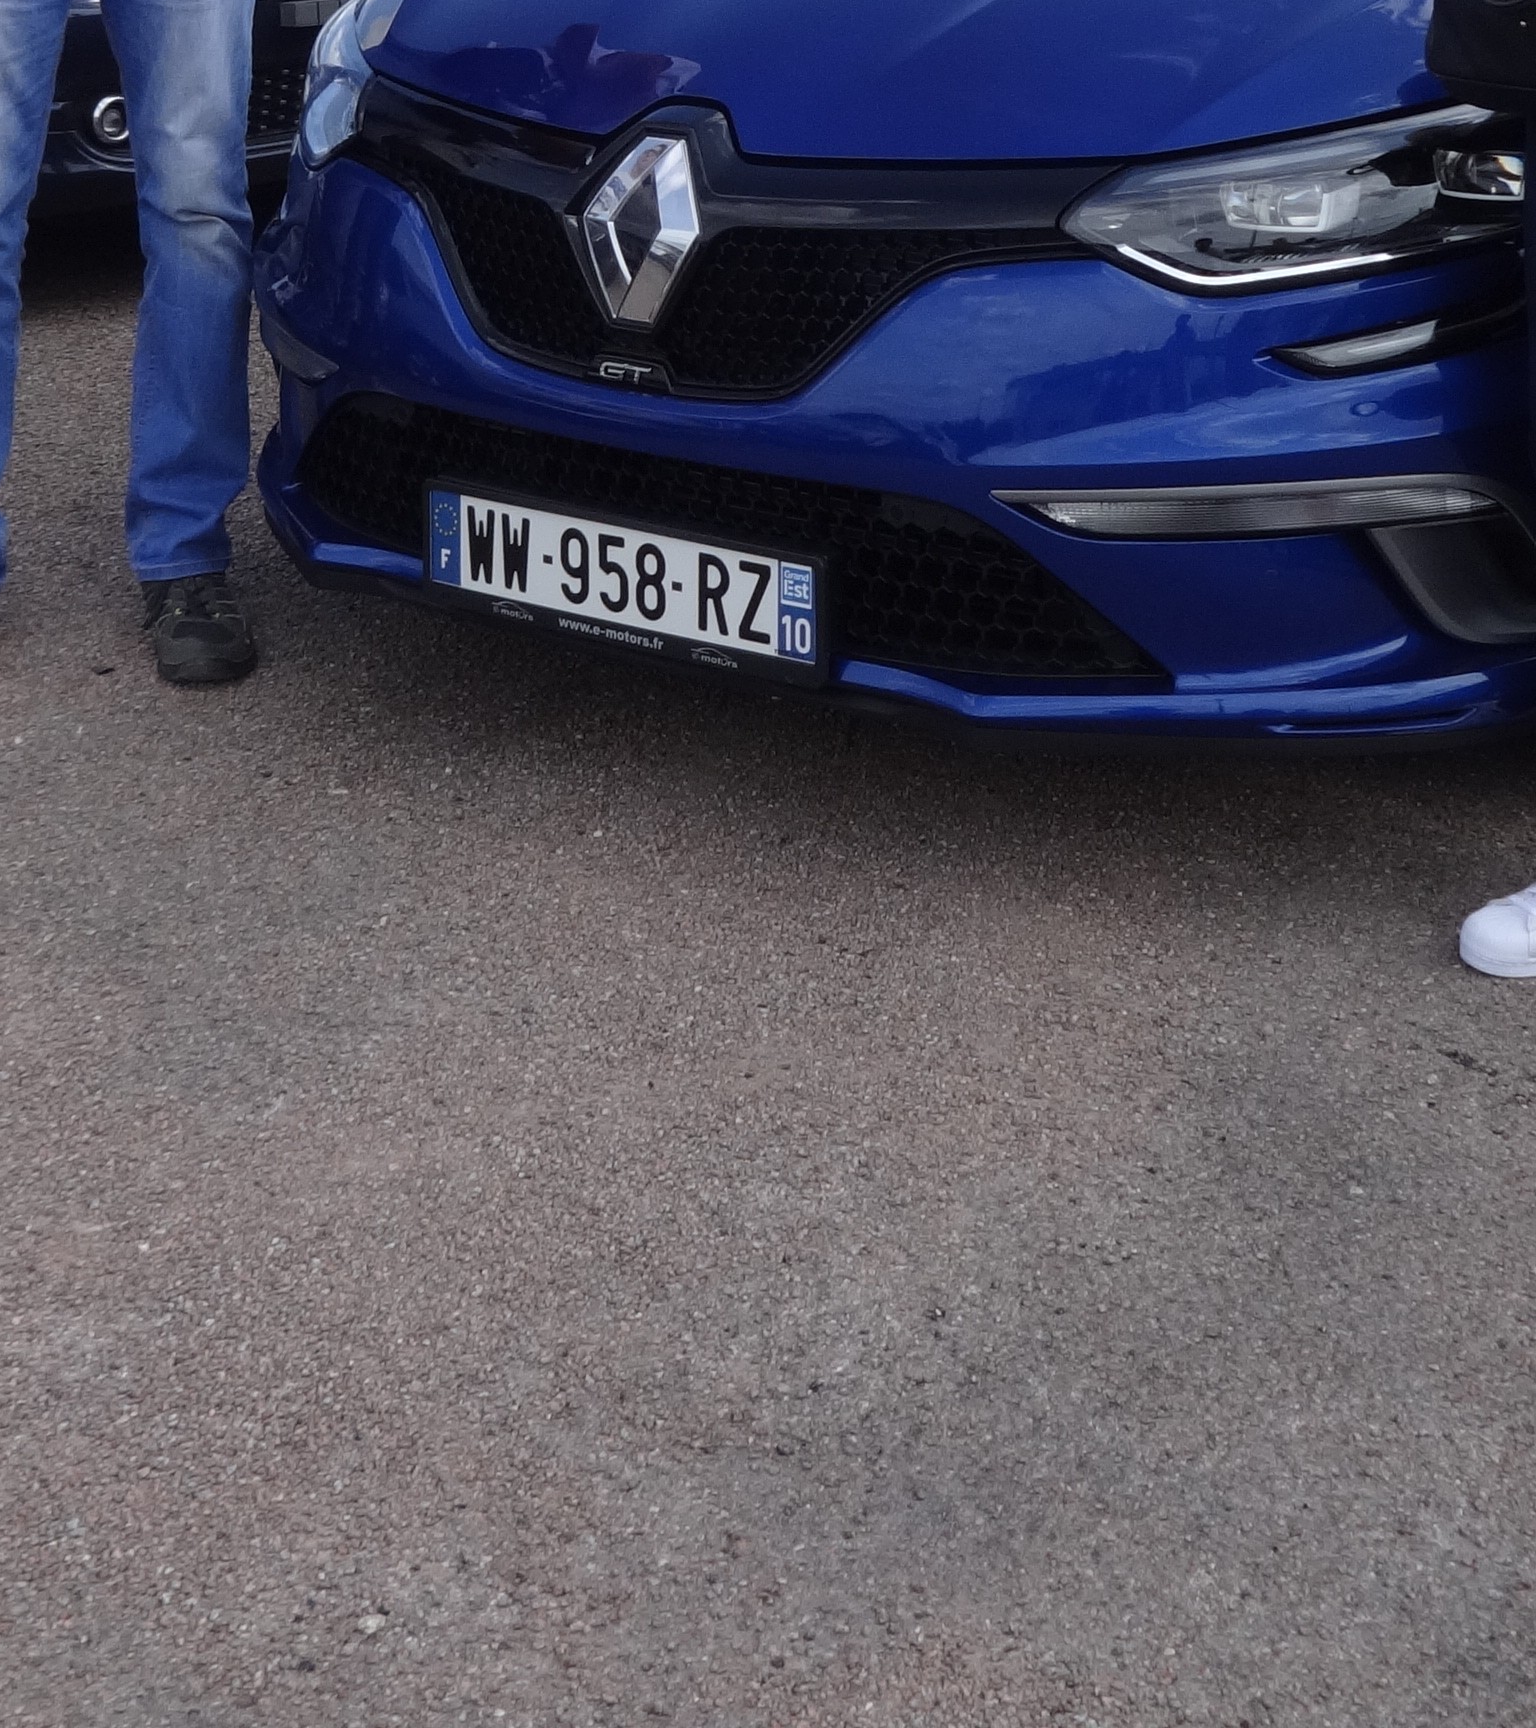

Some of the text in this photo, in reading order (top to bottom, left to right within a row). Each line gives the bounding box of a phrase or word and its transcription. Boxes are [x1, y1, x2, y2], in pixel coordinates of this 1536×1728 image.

[599, 361, 652, 385] GT
[441, 505, 772, 645] F WW-958-RZ
[784, 569, 809, 582] Grand
[784, 579, 809, 601] Est
[559, 617, 664, 651] www.e-motors.fr
[782, 615, 811, 654] 10
